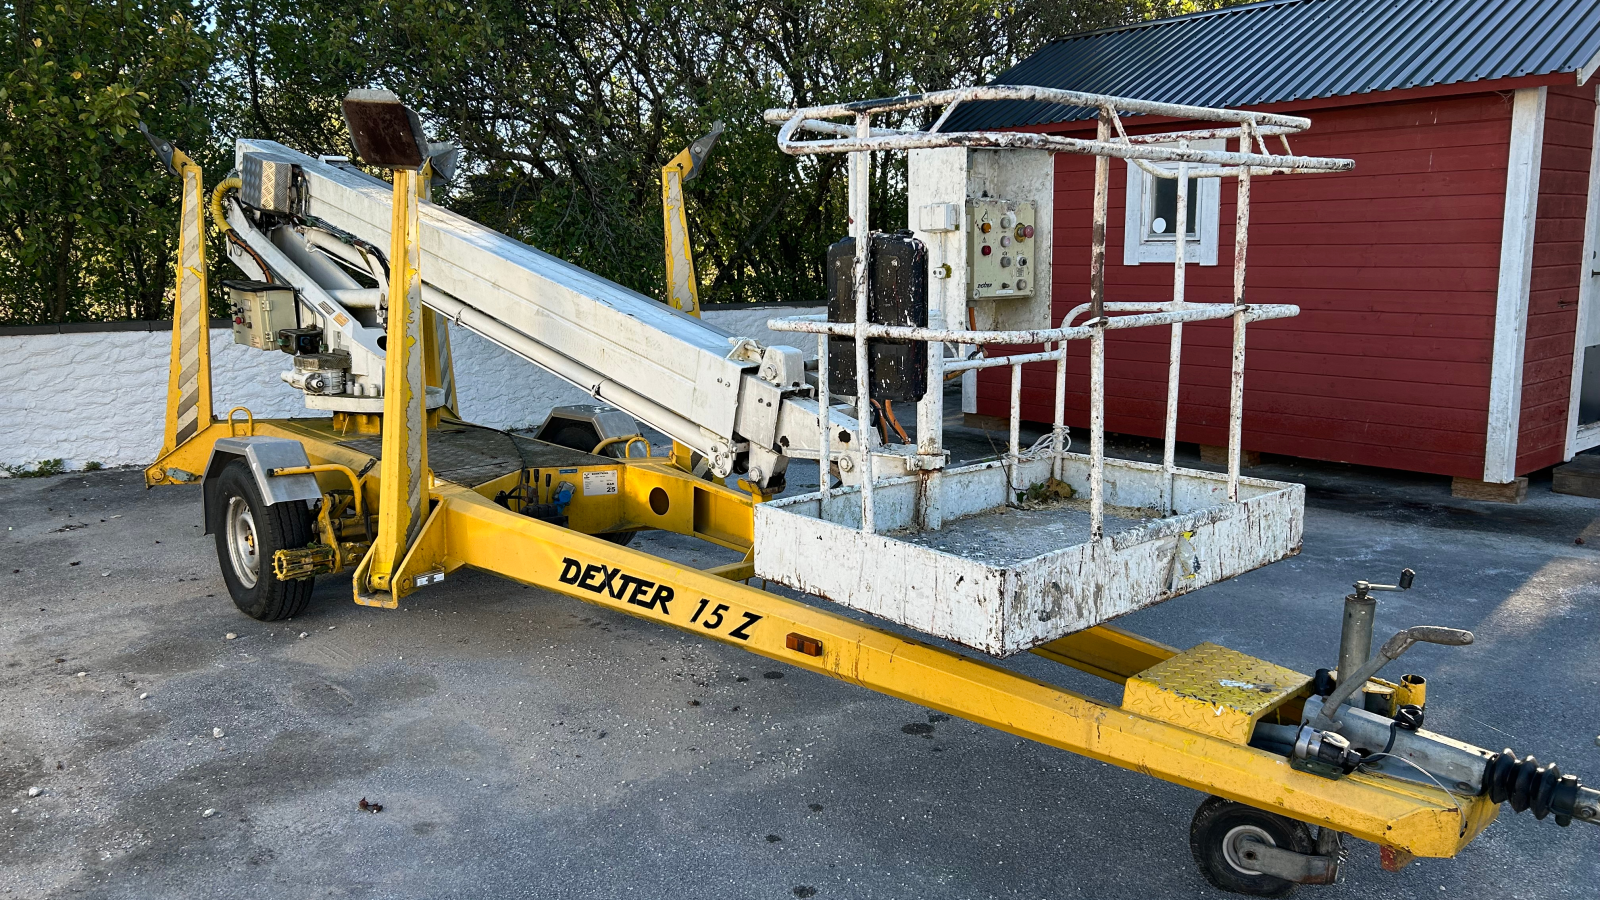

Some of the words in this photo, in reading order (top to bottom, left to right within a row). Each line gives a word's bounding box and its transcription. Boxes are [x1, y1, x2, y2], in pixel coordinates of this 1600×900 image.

[559, 557, 675, 615] DEXTER
[689, 598, 730, 630] 15
[728, 611, 763, 641] Z
